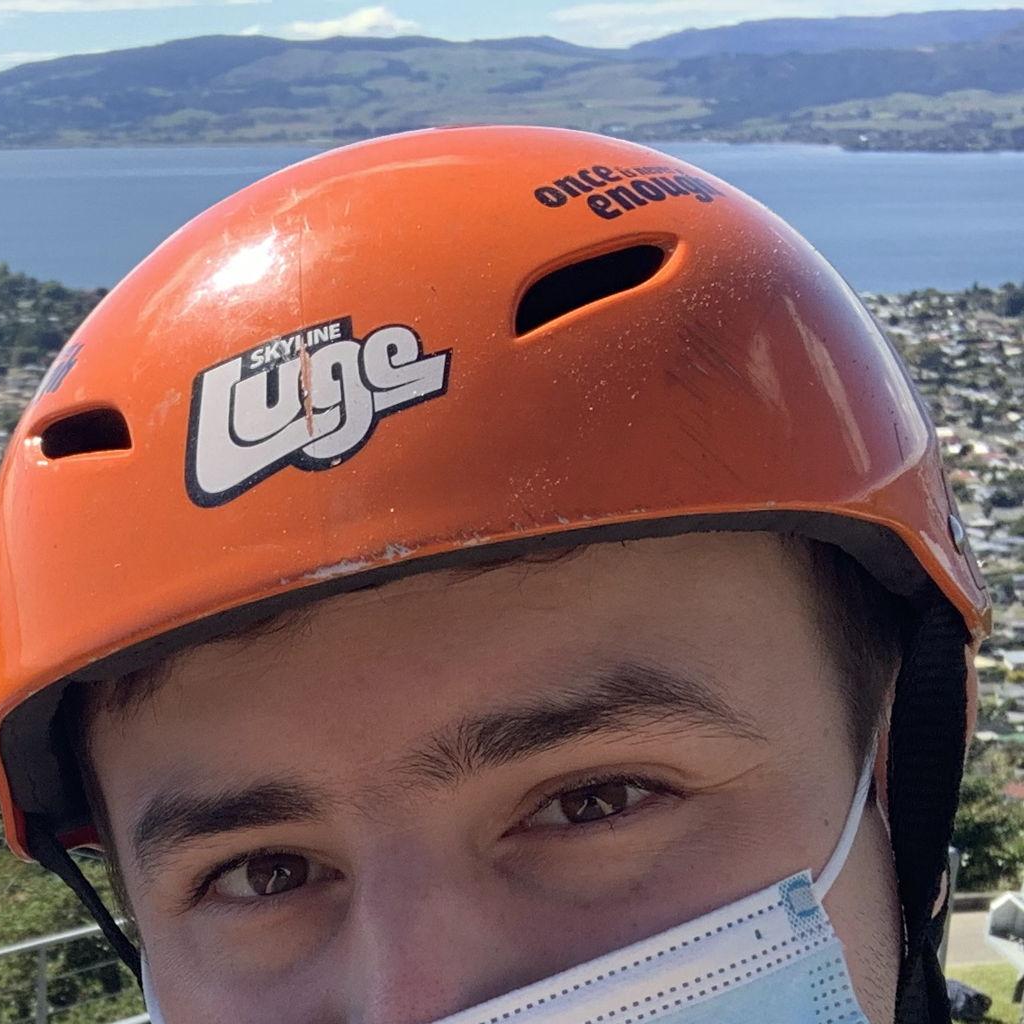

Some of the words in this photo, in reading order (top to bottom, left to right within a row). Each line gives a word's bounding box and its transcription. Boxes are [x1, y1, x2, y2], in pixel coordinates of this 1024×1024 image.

[534, 165, 623, 208] once
[249, 322, 343, 370] SKYLINE
[192, 324, 449, 497] Luge
